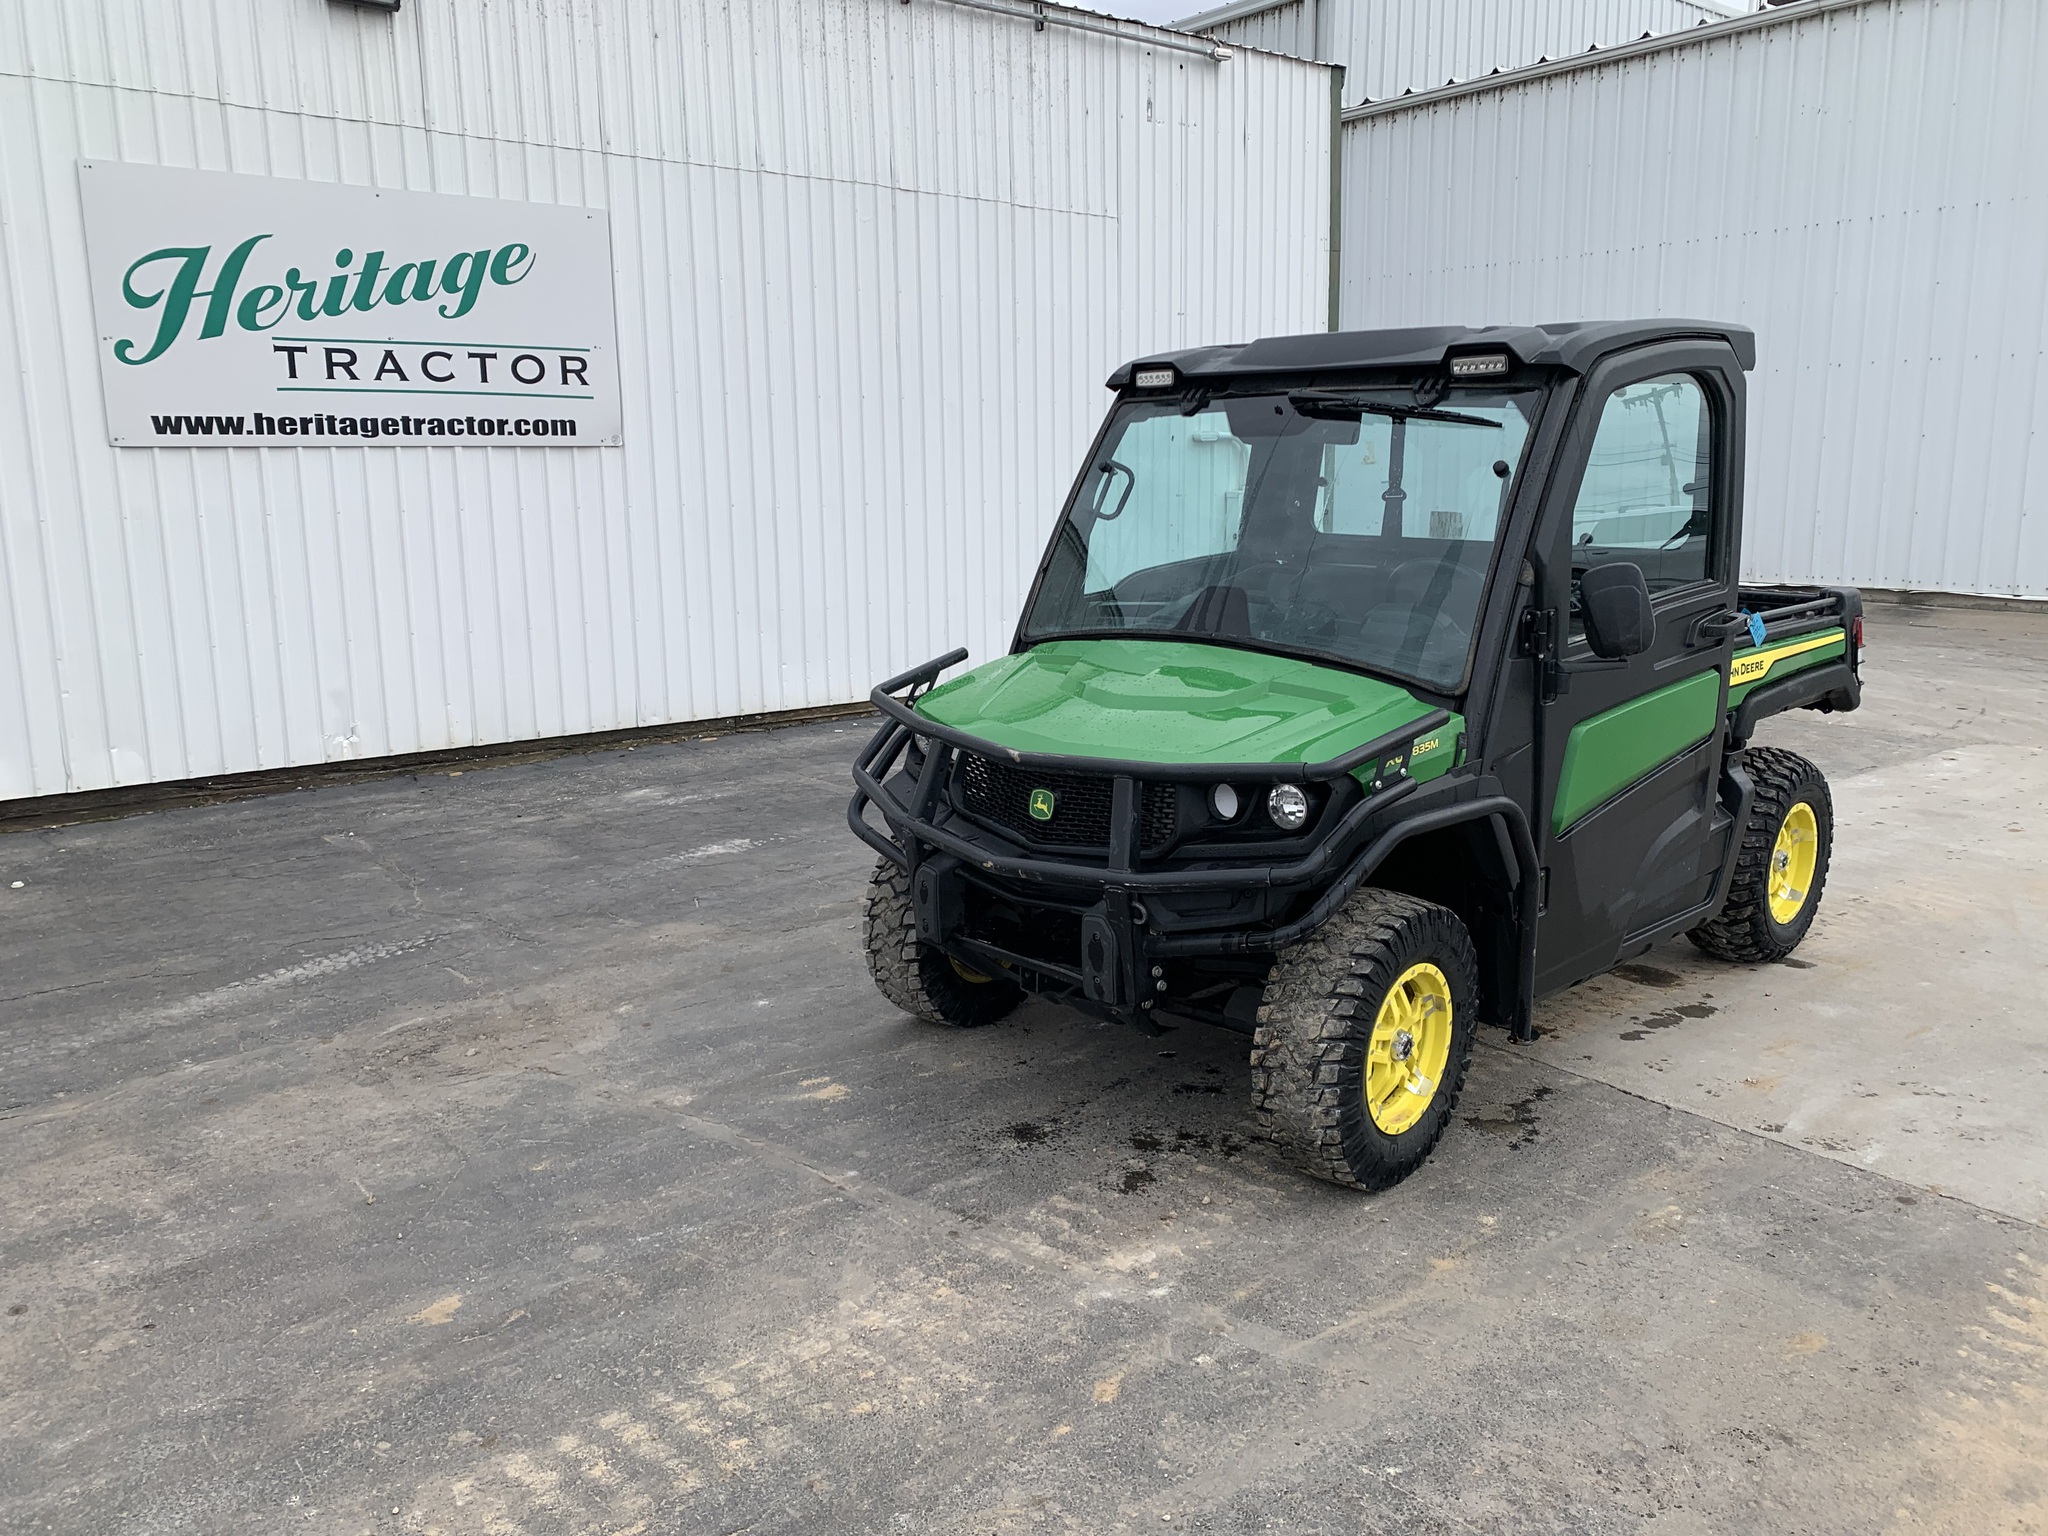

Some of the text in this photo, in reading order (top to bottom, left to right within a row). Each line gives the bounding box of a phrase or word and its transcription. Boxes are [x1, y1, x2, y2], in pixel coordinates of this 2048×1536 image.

[112, 233, 537, 366] Heritage
[272, 344, 591, 386] TRACTOR
[150, 412, 577, 438] www.heritagetractor.com
[1741, 660, 1764, 675] DEERE
[1412, 738, 1439, 756] 835M
